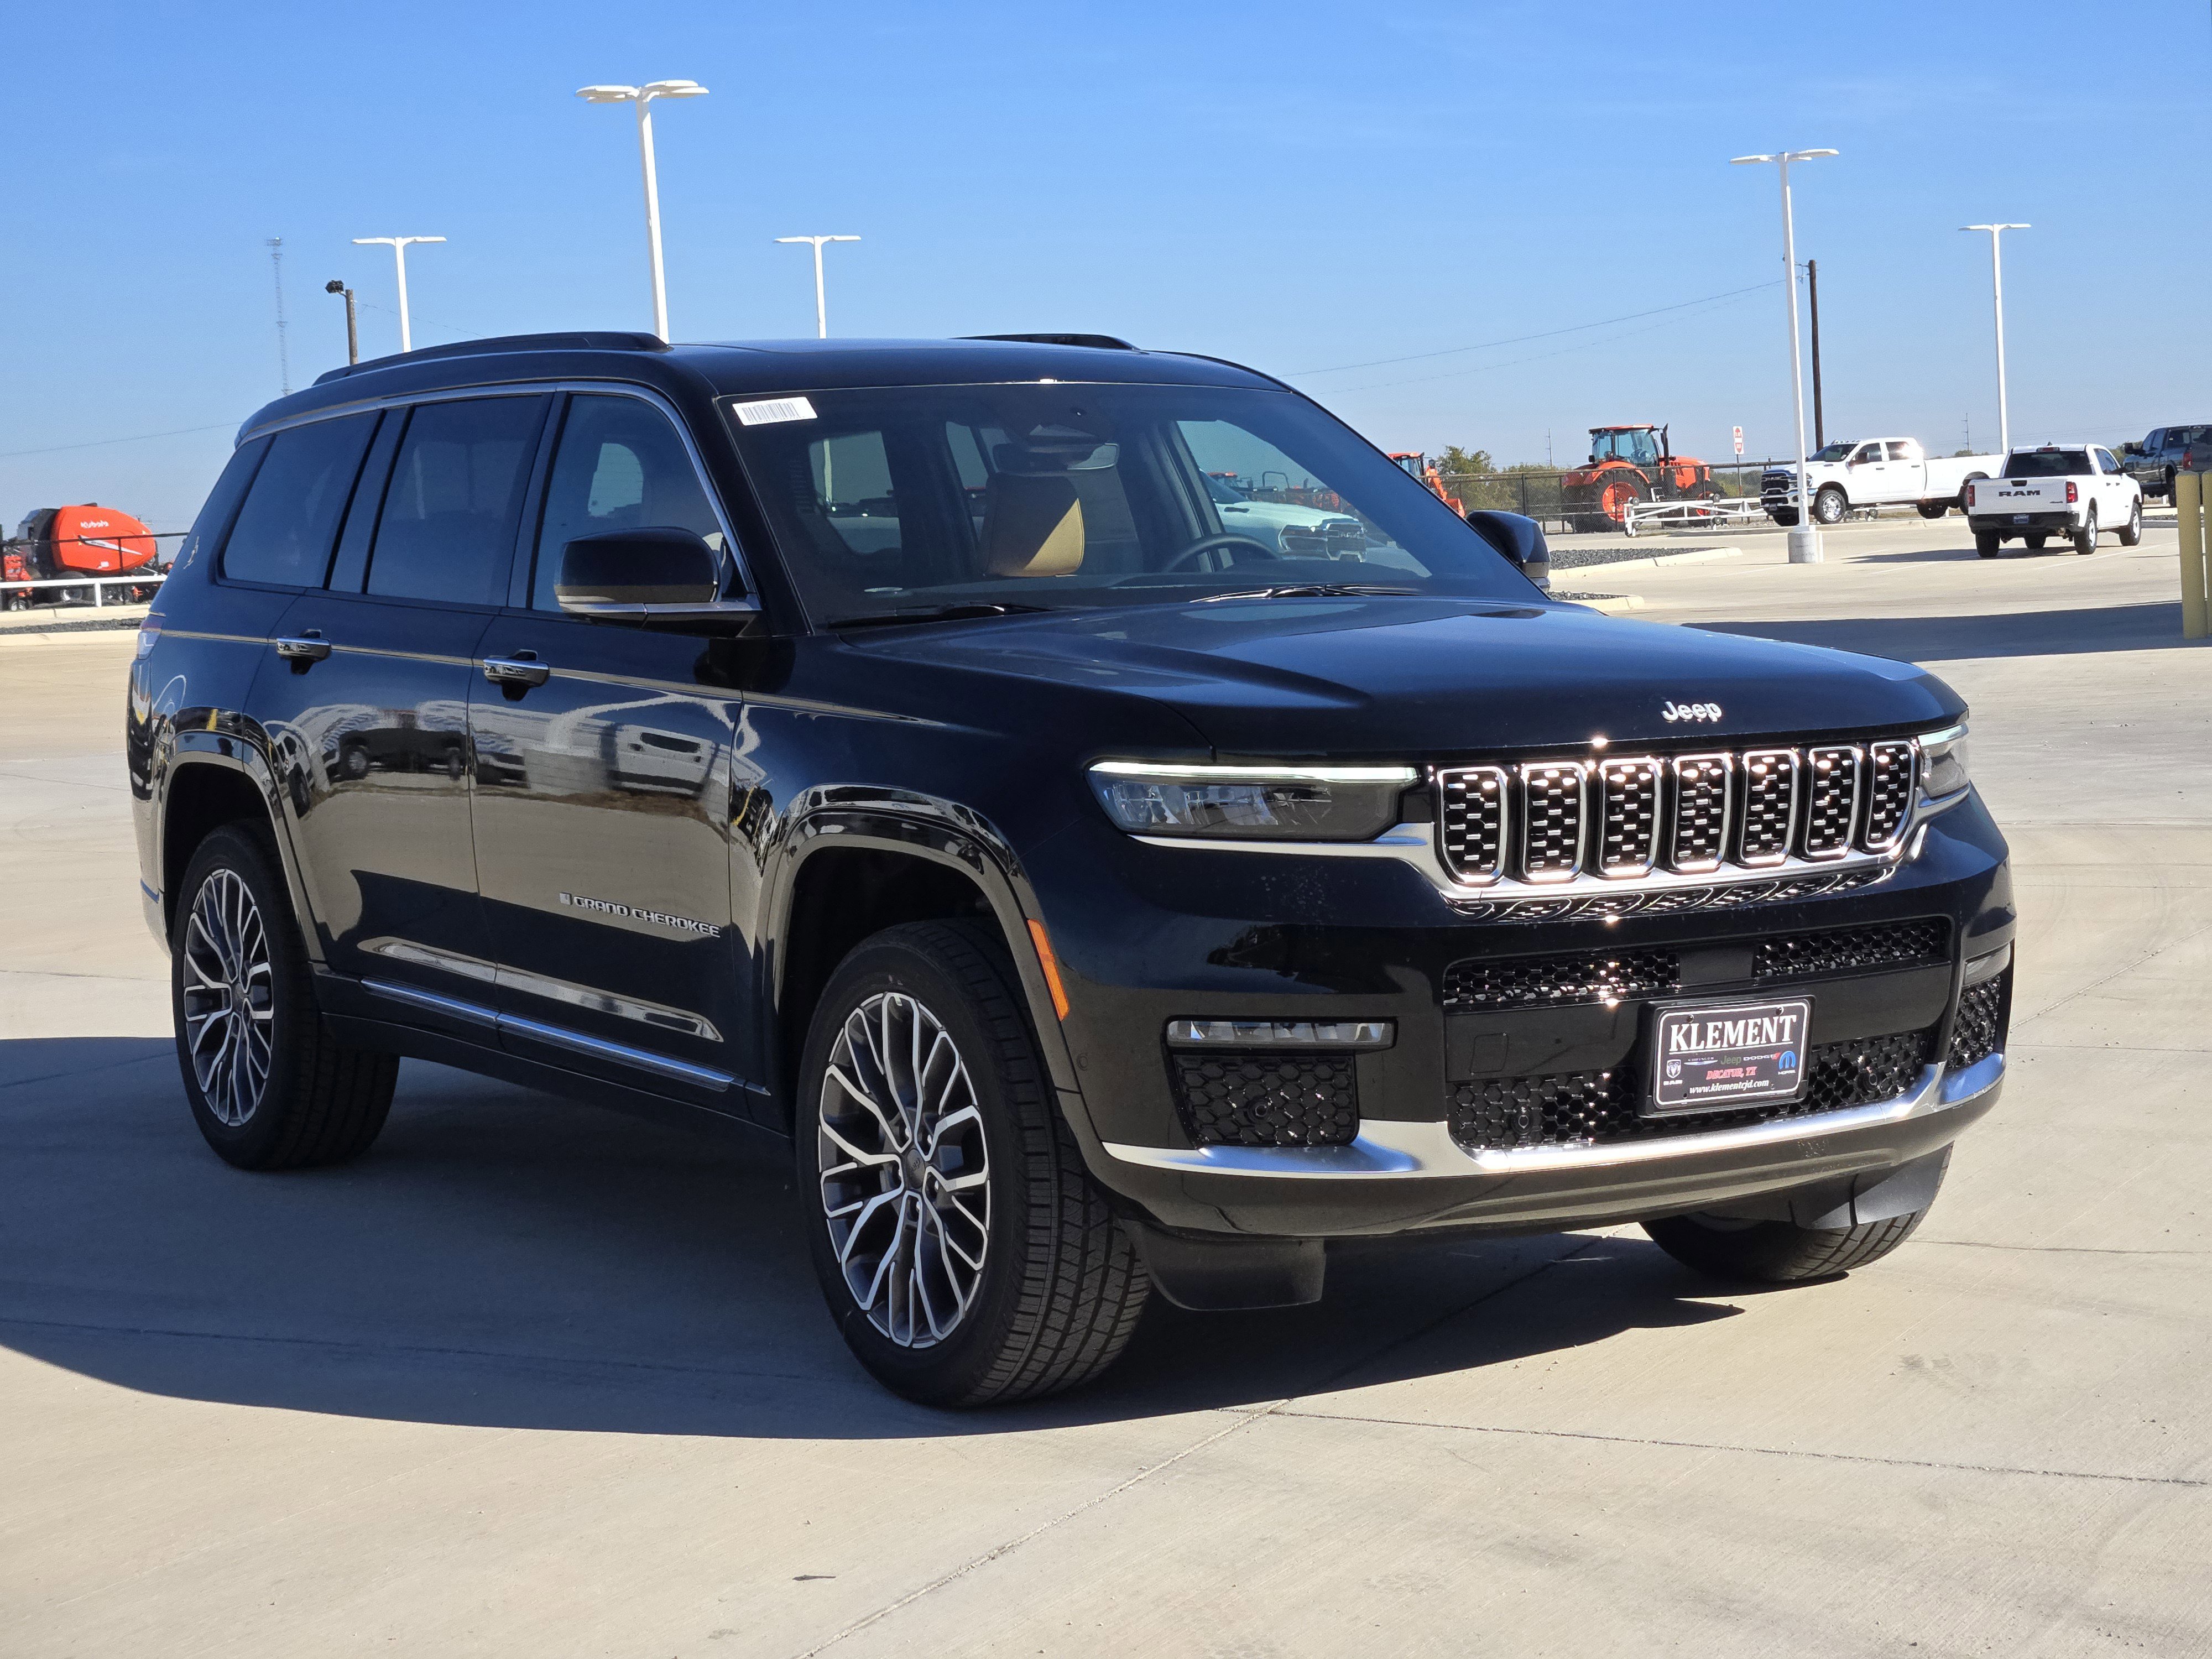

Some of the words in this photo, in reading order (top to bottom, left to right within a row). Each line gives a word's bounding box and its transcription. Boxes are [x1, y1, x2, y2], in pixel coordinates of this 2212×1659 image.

[1661, 701, 1722, 722] Jeep
[573, 896, 630, 917] GRAND
[632, 907, 721, 938] CHEROKEE
[1669, 1015, 1797, 1051] KLEMENT
[1720, 1055, 1741, 1065] Jeep
[1689, 1079, 1770, 1094] www.klementcjd.com
